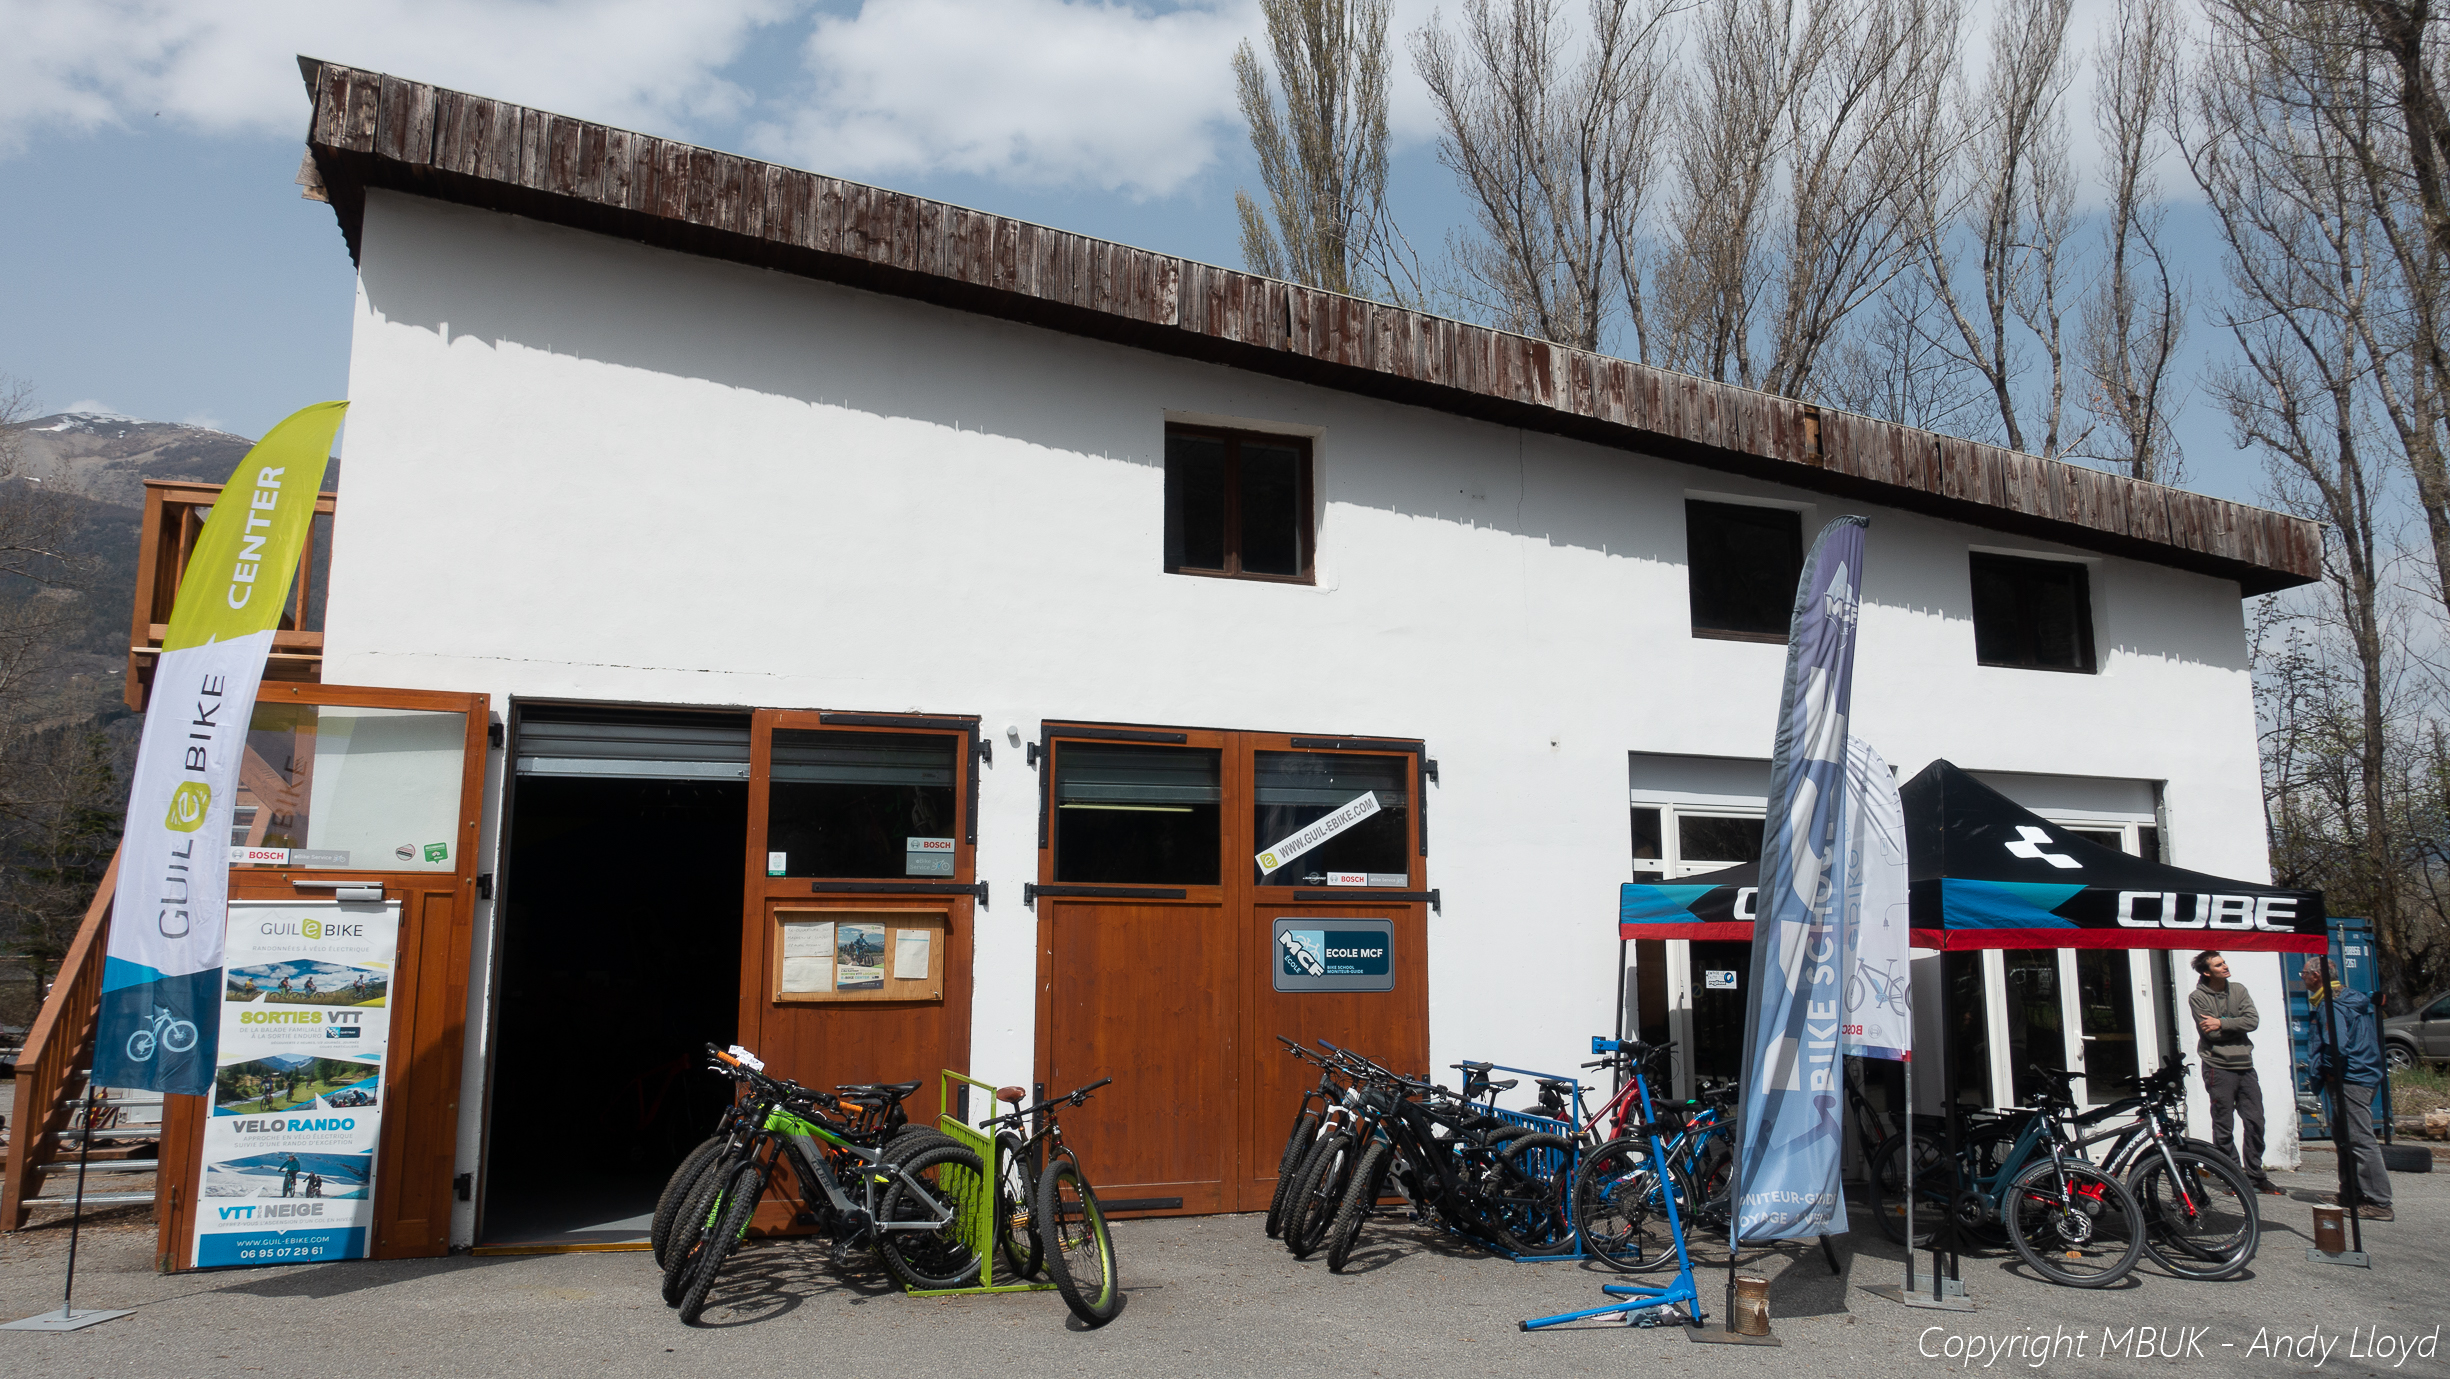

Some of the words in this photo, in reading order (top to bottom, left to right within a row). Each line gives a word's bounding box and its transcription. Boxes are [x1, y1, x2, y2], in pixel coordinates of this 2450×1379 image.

[227, 466, 286, 610] CENTER
[158, 839, 194, 939] GUIL
[185, 673, 226, 773] BIKE
[1278, 798, 1375, 859] WWW.GUIL-EBIKE.COM
[923, 841, 951, 849] BOSCH
[248, 851, 285, 860] BOSCH
[310, 853, 333, 861] Service
[909, 863, 931, 871] Service
[1340, 875, 1365, 883] BOSCH
[2116, 890, 2298, 933] CUBE
[260, 922, 300, 936] GUIL
[324, 924, 364, 937] BIKE
[252, 945, 301, 953] RANDONNÉES
[309, 945, 326, 953] VÉLO
[328, 945, 370, 954] ÉLECTRIQUE
[1279, 929, 1325, 977] MCF
[1326, 948, 1358, 958] ECOLE
[1360, 948, 1383, 958] MCF
[1283, 954, 1302, 974] ÉCOLE
[240, 1011, 323, 1025] SORTIES
[327, 1011, 363, 1024] VTT
[1807, 999, 1838, 1092] BIKE
[233, 1120, 286, 1134] VELO
[287, 1118, 356, 1132] RANDO
[308, 1139, 353, 1147] D'EXCEPTION
[312, 1132, 354, 1140] ÉLECTRIQUE
[811, 1160, 834, 1193] CUBE
[218, 1205, 257, 1220] VTT
[264, 1203, 324, 1218] NEIGE
[1740, 1211, 1788, 1228] OYAGE
[236, 1236, 330, 1247] WWW.GUIL-EBIKE.COM
[240, 1249, 256, 1259] 06
[258, 1248, 274, 1258] 95
[276, 1247, 292, 1257] 07
[293, 1246, 309, 1256] 29
[311, 1246, 324, 1255] 61
